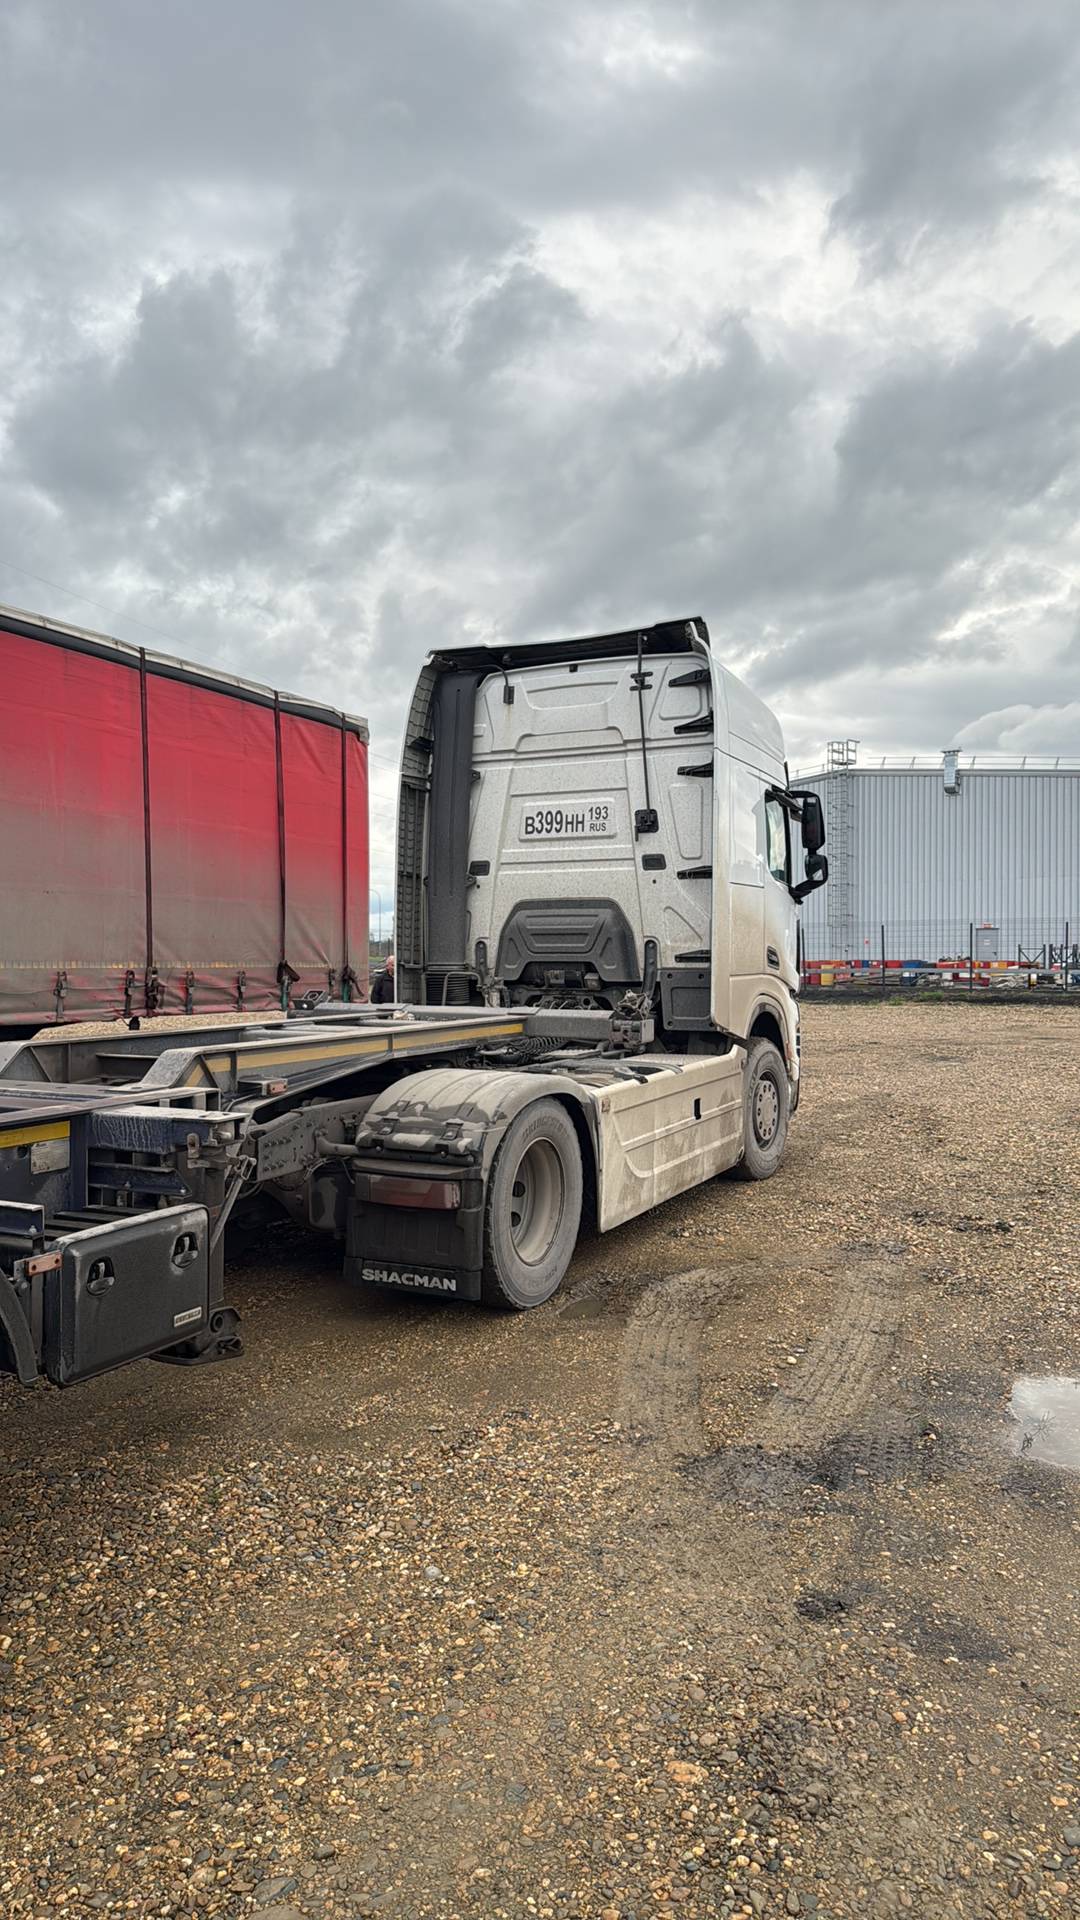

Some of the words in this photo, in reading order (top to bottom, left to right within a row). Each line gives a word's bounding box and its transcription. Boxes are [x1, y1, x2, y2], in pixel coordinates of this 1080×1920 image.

[588, 806, 609, 820] 193
[589, 822, 607, 832] RUS
[362, 1268, 457, 1291] SHACMAN
